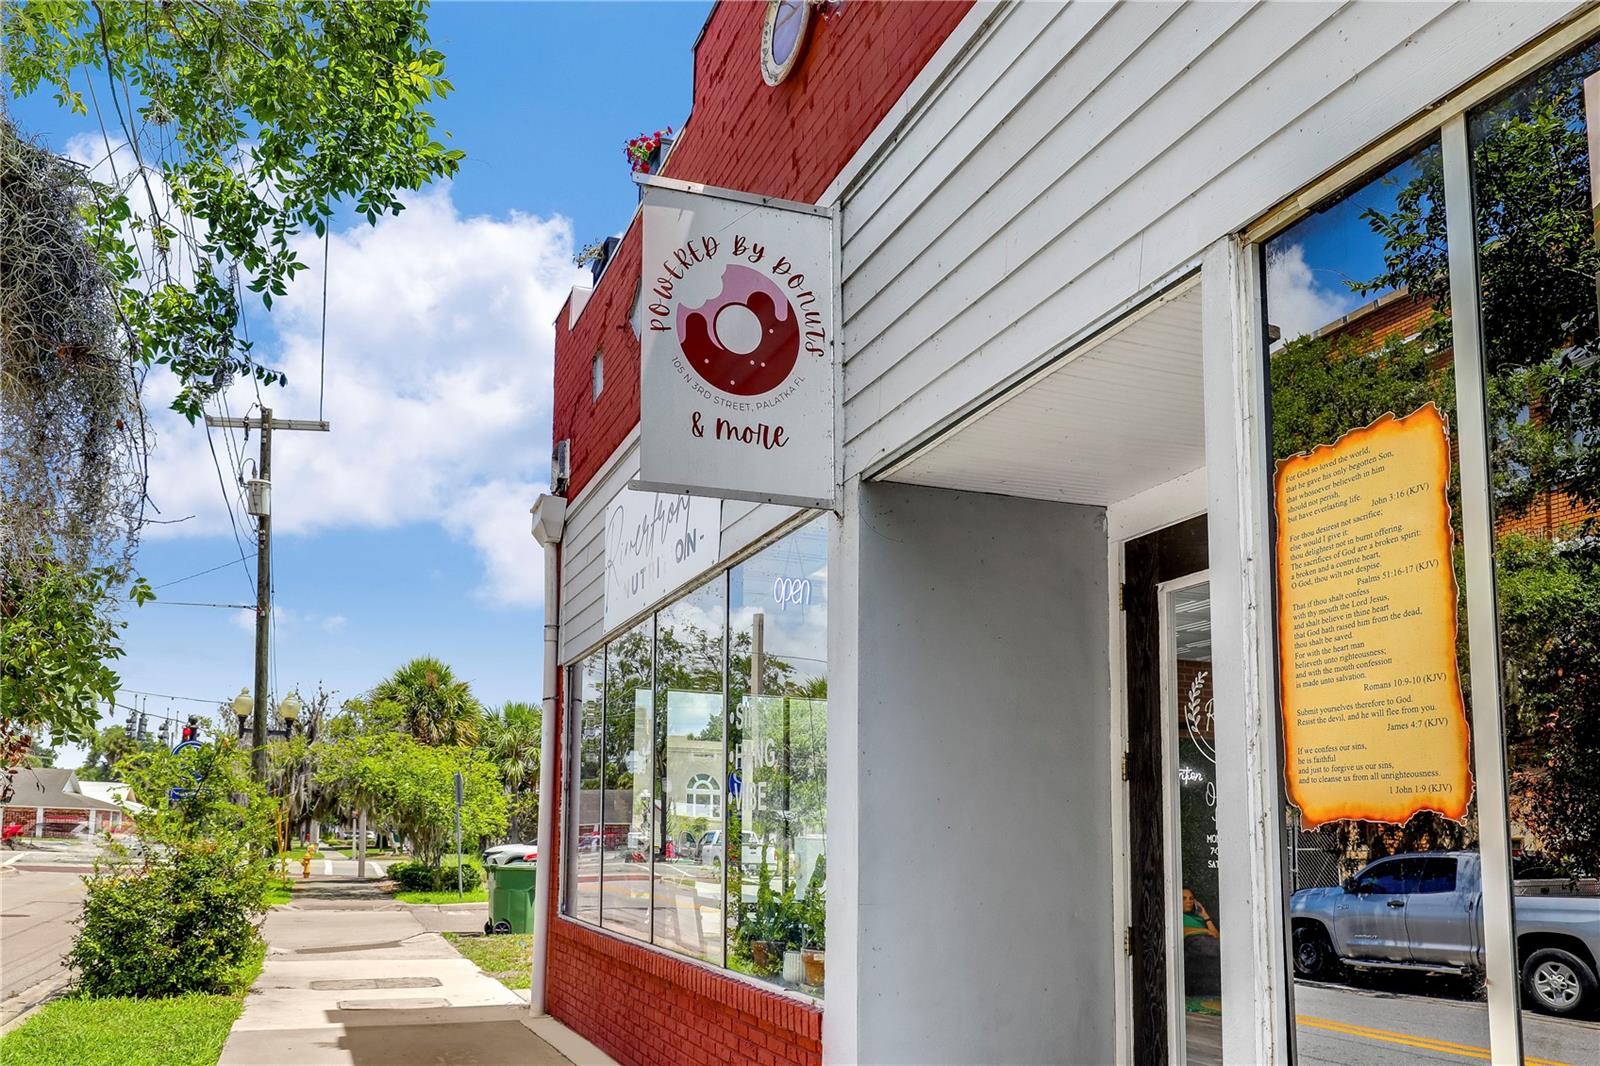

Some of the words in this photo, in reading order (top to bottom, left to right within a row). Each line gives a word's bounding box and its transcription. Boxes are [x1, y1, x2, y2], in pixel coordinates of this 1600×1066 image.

[649, 235, 720, 332] POWERED
[671, 356, 686, 373] 105
[683, 373, 693, 384] N
[691, 381, 712, 400] 3RD
[756, 386, 797, 411] PALATKA
[795, 375, 806, 386] FL
[691, 411, 705, 438] &
[1371, 496, 1388, 507] John
[1389, 491, 1405, 502] 3:16
[1406, 482, 1430, 497] (KJV)
[1356, 573, 1381, 585] Psalms
[1382, 565, 1414, 580] 51:16-17
[1415, 559, 1439, 572] (KJV)
[773, 576, 811, 611] open
[1363, 681, 1392, 691] Romans
[1393, 675, 1421, 687] 10:9-10
[1422, 672, 1447, 683] (KJV)
[1387, 723, 1409, 731] James
[1410, 720, 1423, 728] 4:7
[1424, 718, 1448, 727] (KJV)
[1395, 785, 1413, 793] John
[1414, 784, 1427, 793] 1:9
[1428, 784, 1452, 793] (KJV)
